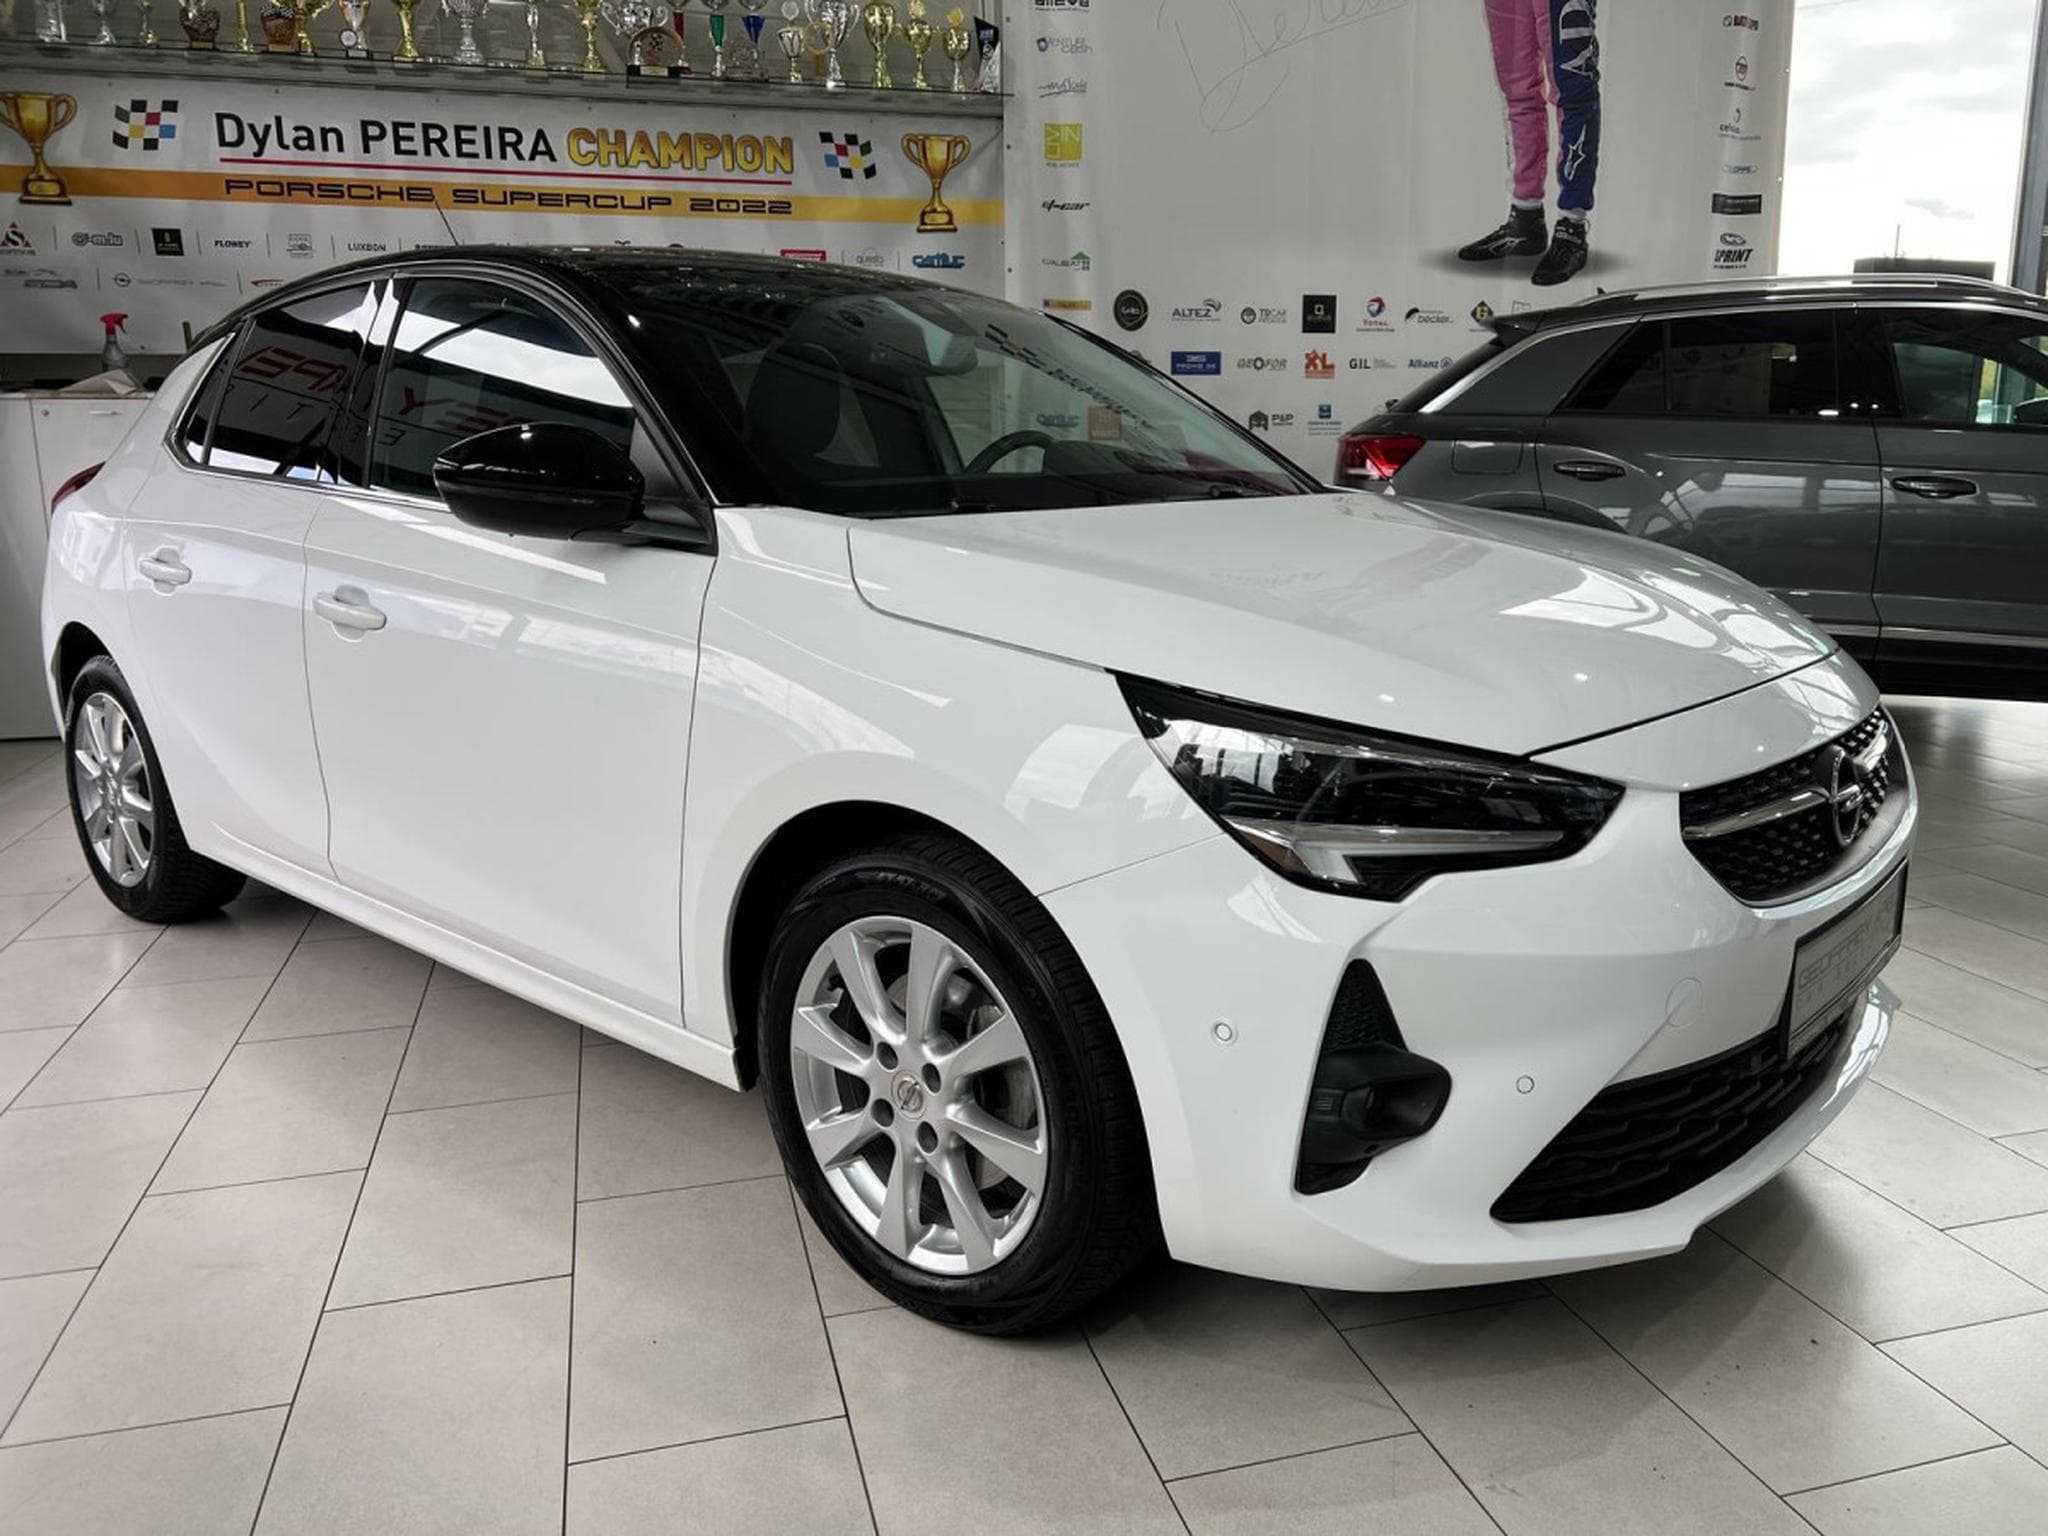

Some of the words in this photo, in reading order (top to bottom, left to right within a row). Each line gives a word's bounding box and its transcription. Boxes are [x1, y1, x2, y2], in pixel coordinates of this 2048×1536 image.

[215, 112, 345, 157] Dylan
[359, 119, 557, 163] PEREIRA
[566, 127, 794, 174] CHAMPION
[225, 179, 436, 202] PORSCHE
[452, 188, 672, 211] SUPERCUP
[689, 198, 793, 215] 2022
[214, 239, 251, 249] FLOWEY
[1171, 308, 1212, 318] ALTEZ
[1362, 319, 1388, 327] TOTAL
[1349, 358, 1371, 370] GIL
[1408, 359, 1440, 370] Allianz
